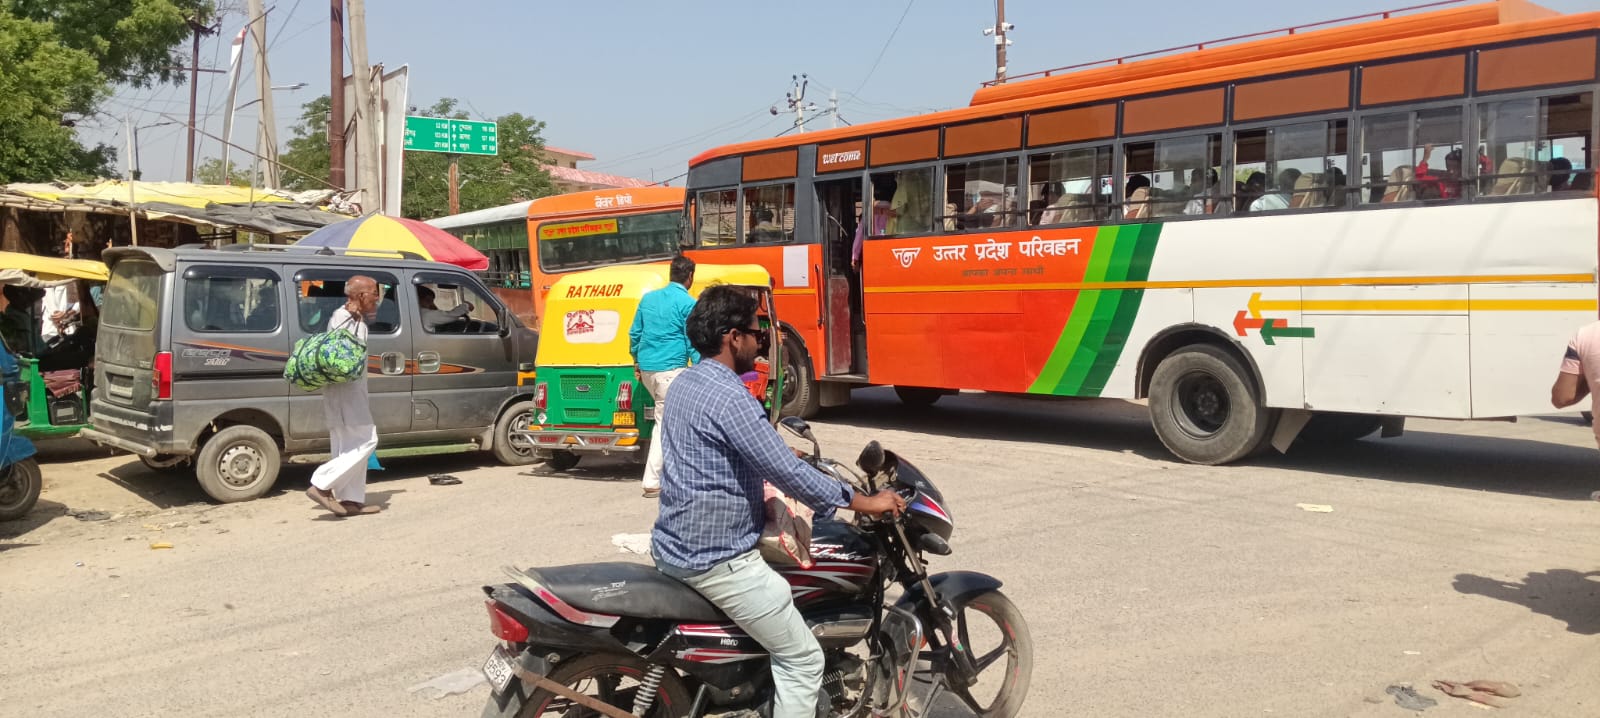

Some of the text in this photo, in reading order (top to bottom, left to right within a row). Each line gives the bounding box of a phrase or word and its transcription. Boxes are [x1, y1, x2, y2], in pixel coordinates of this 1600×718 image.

[932, 236, 1081, 261] उत्तर प्रदेश परिवहन
[566, 284, 623, 298] RATHAUR
[720, 637, 739, 647] Hero
[486, 660, 506, 685] 9593
